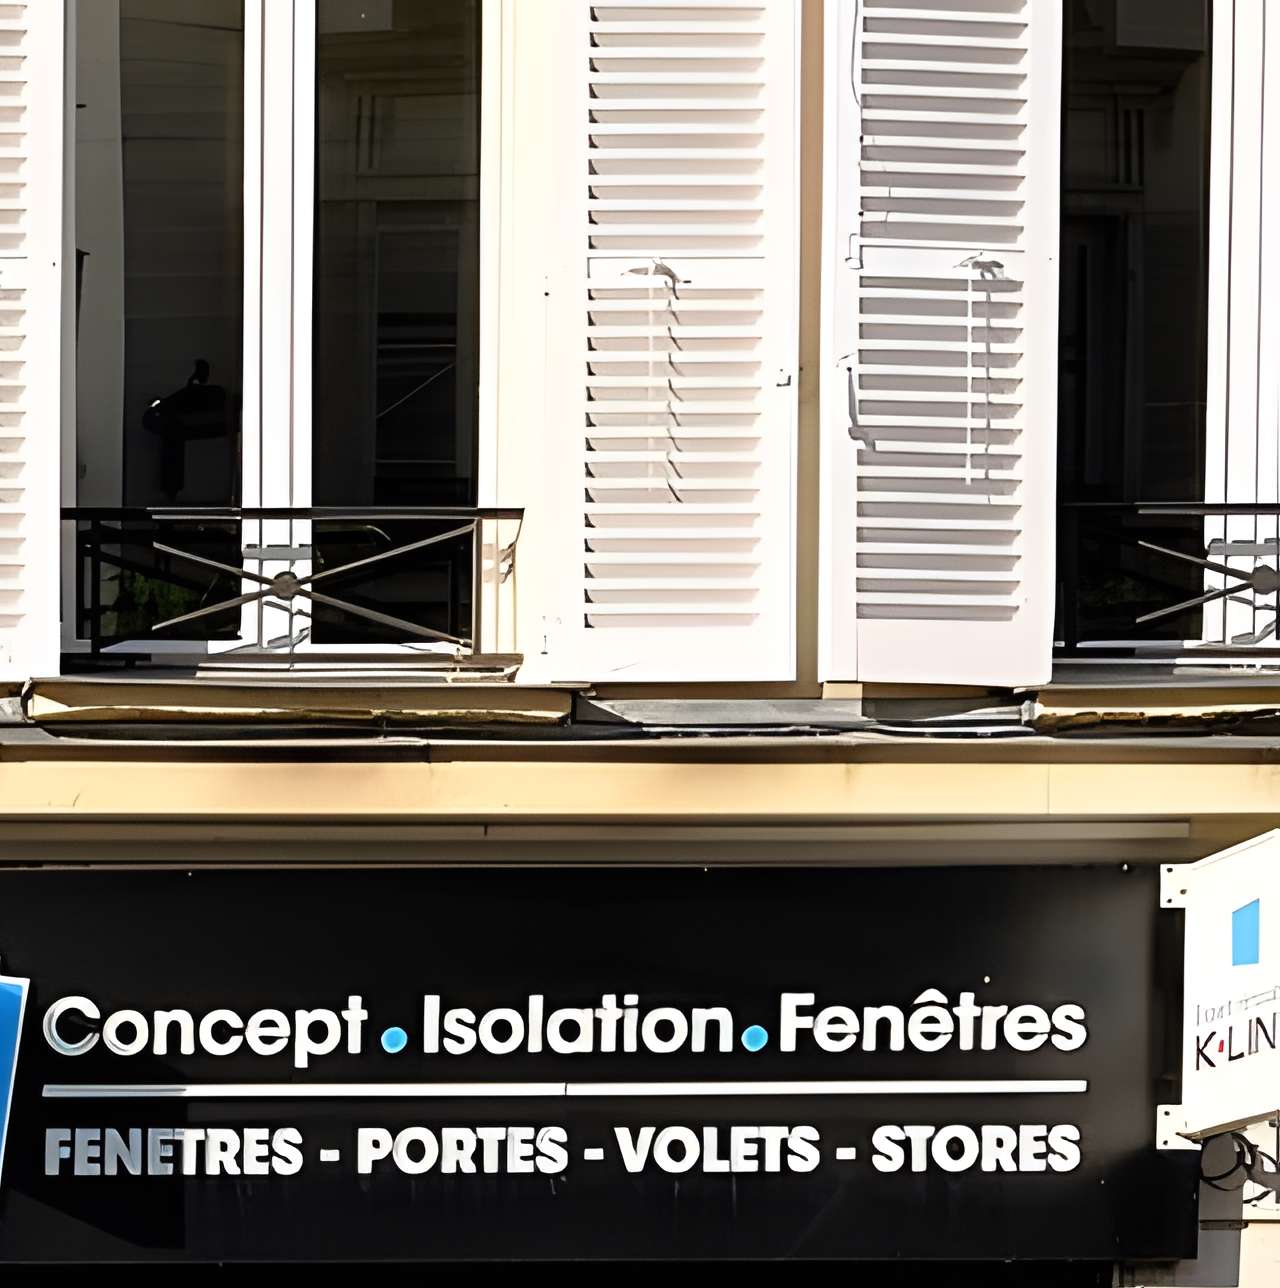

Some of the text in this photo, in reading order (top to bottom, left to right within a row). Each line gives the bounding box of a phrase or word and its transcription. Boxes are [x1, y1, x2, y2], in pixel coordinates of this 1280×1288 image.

[42, 988, 1087, 1068] Concept Isolation Fenêtres
[44, 1127, 303, 1176] FENETRES
[356, 1126, 568, 1175] PORTES
[614, 1125, 821, 1173] VOLETS
[871, 1124, 1082, 1173] STORES
